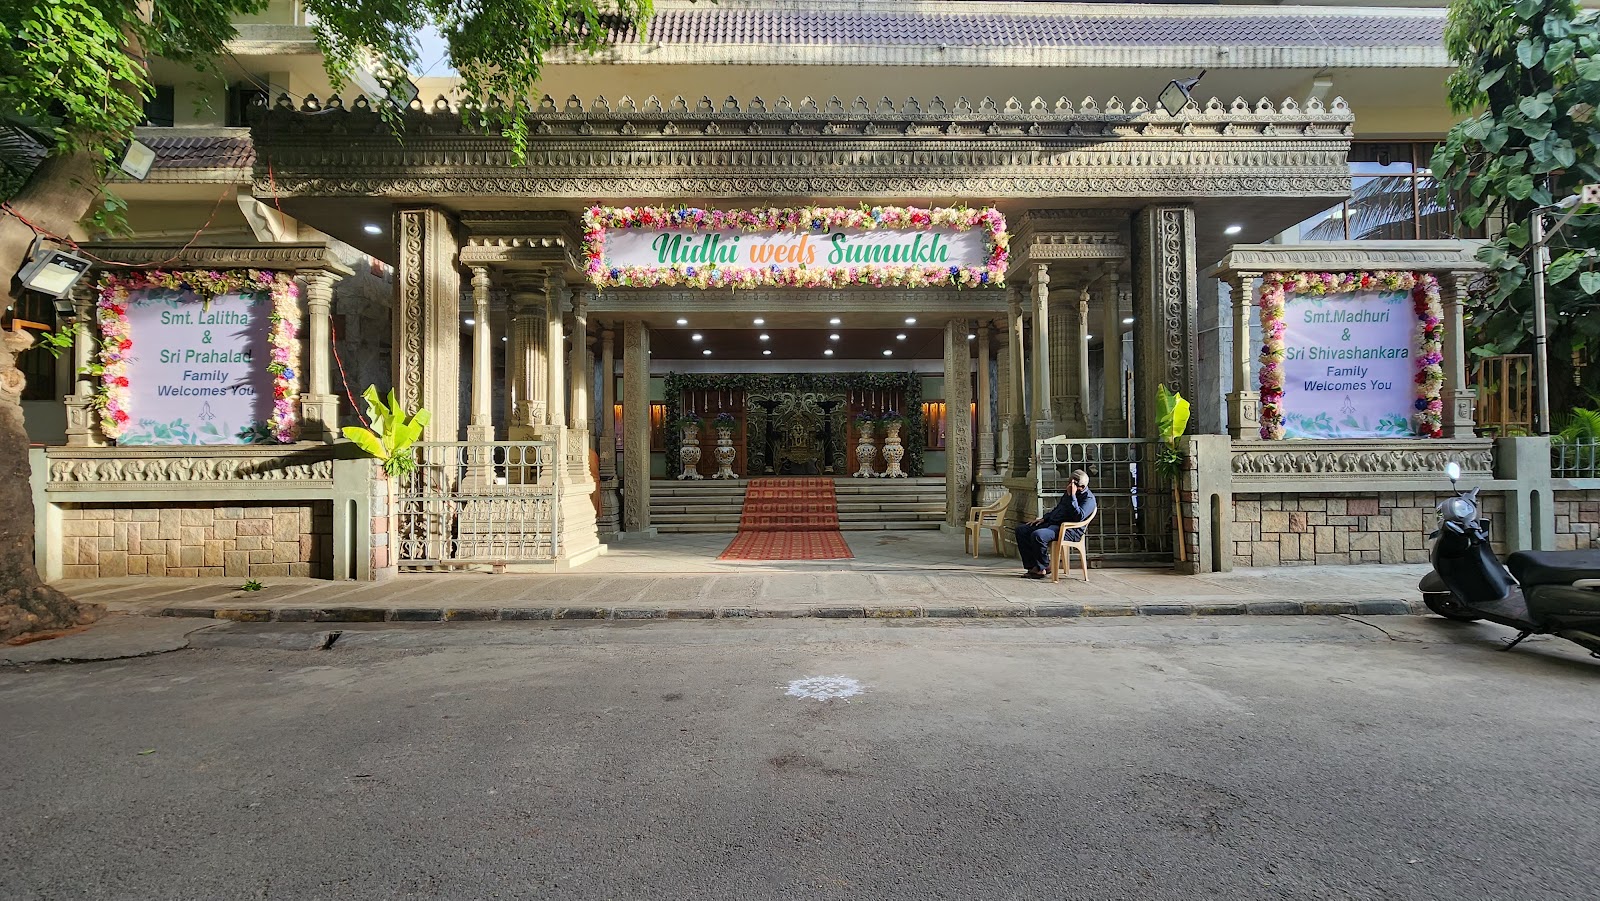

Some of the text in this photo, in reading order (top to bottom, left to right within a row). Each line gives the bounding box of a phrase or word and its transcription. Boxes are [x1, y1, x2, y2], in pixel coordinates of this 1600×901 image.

[651, 232, 950, 265] Nidhi weds Sumukh
[160, 310, 249, 325] Smt. Lalitha
[201, 329, 213, 344] &
[1341, 327, 1351, 341] &
[159, 348, 253, 364] Sri Prahalad
[1286, 346, 1409, 361] Sri Shivashankara
[183, 369, 229, 384] Family
[1326, 365, 1369, 379] Family
[157, 384, 255, 396] Welcomes You
[1304, 379, 1392, 391] Welcomes You
